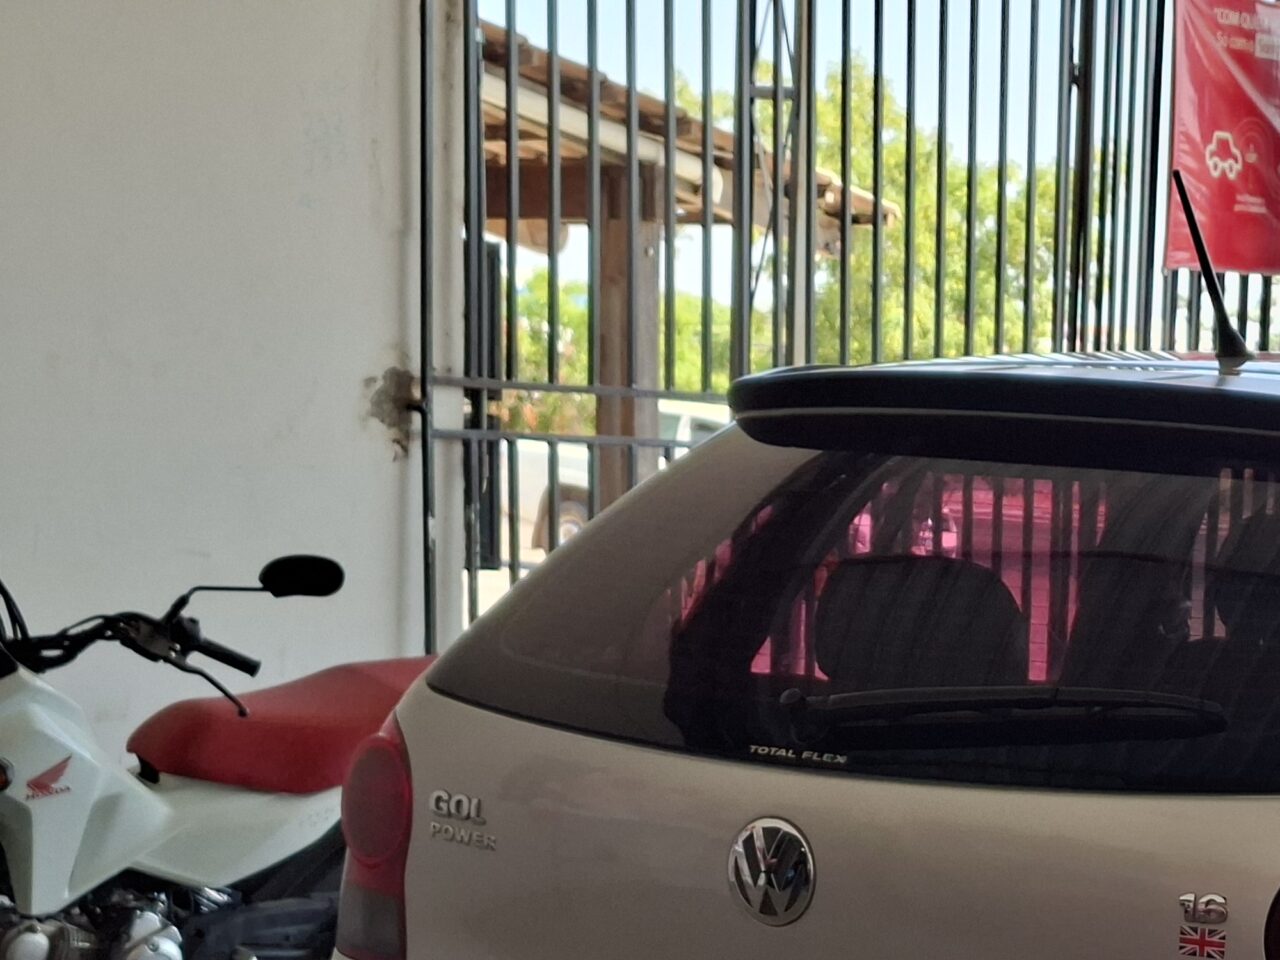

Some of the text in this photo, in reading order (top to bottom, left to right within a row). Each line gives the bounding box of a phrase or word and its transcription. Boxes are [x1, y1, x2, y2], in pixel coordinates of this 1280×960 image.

[749, 744, 848, 763] TOTAL FLEX
[429, 789, 487, 826] GOL
[431, 821, 497, 852] POWER
